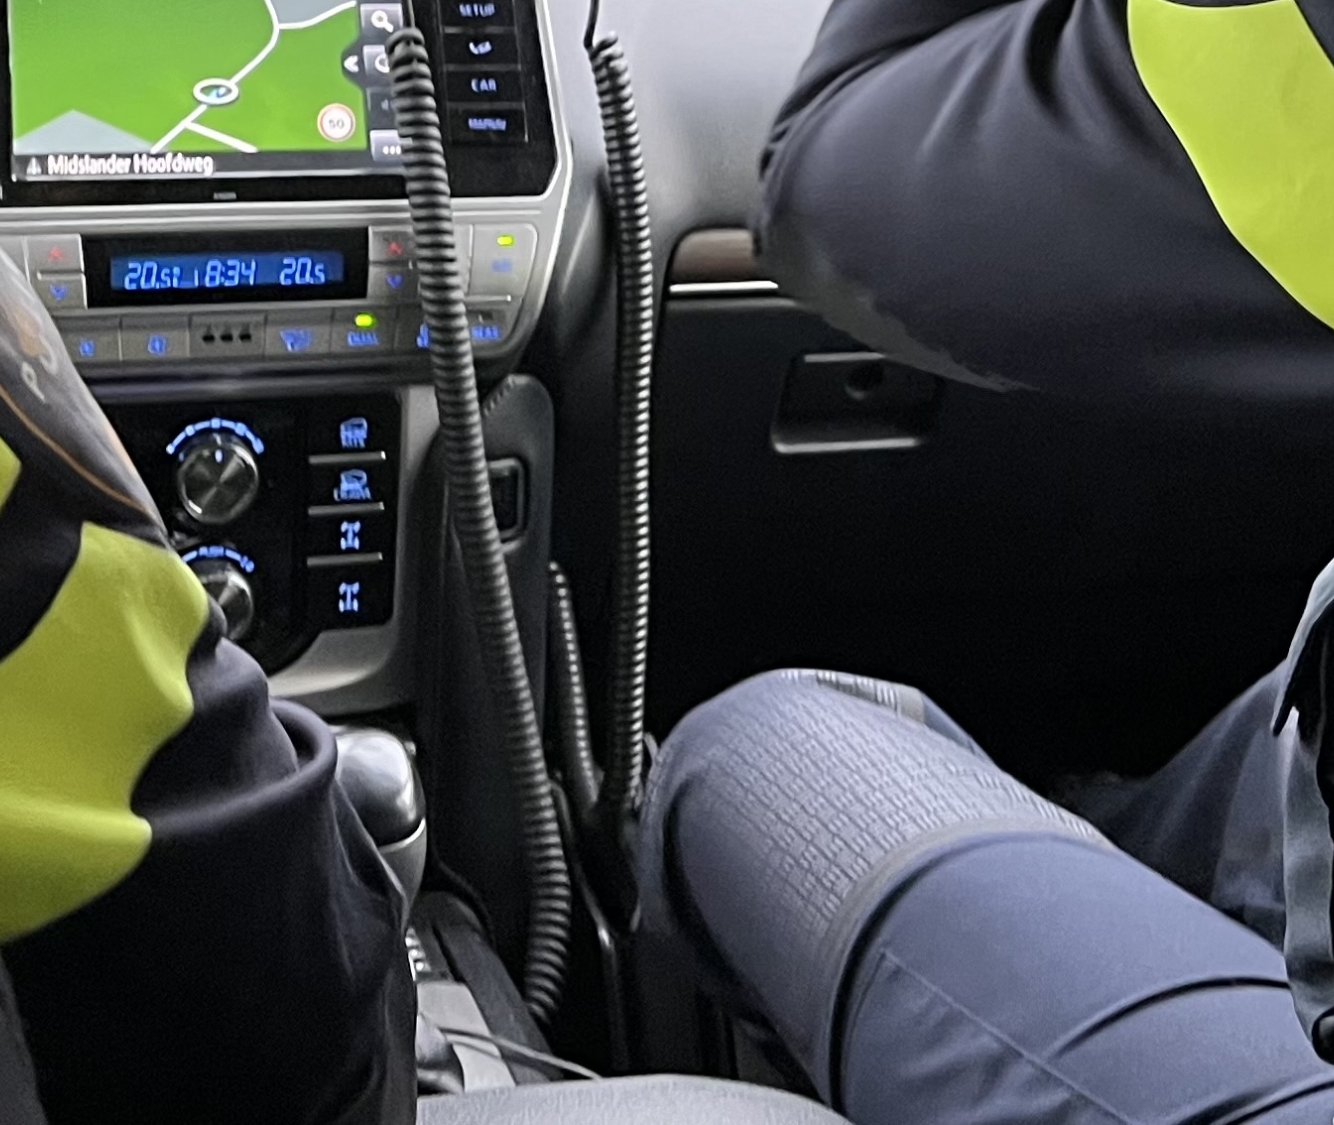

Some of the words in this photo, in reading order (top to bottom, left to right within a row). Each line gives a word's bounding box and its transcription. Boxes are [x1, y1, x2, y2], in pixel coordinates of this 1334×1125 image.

[470, 78, 497, 93] CAR
[328, 117, 346, 131] 50
[47, 154, 132, 176] Midslander
[133, 153, 214, 177] Hoofdweg
